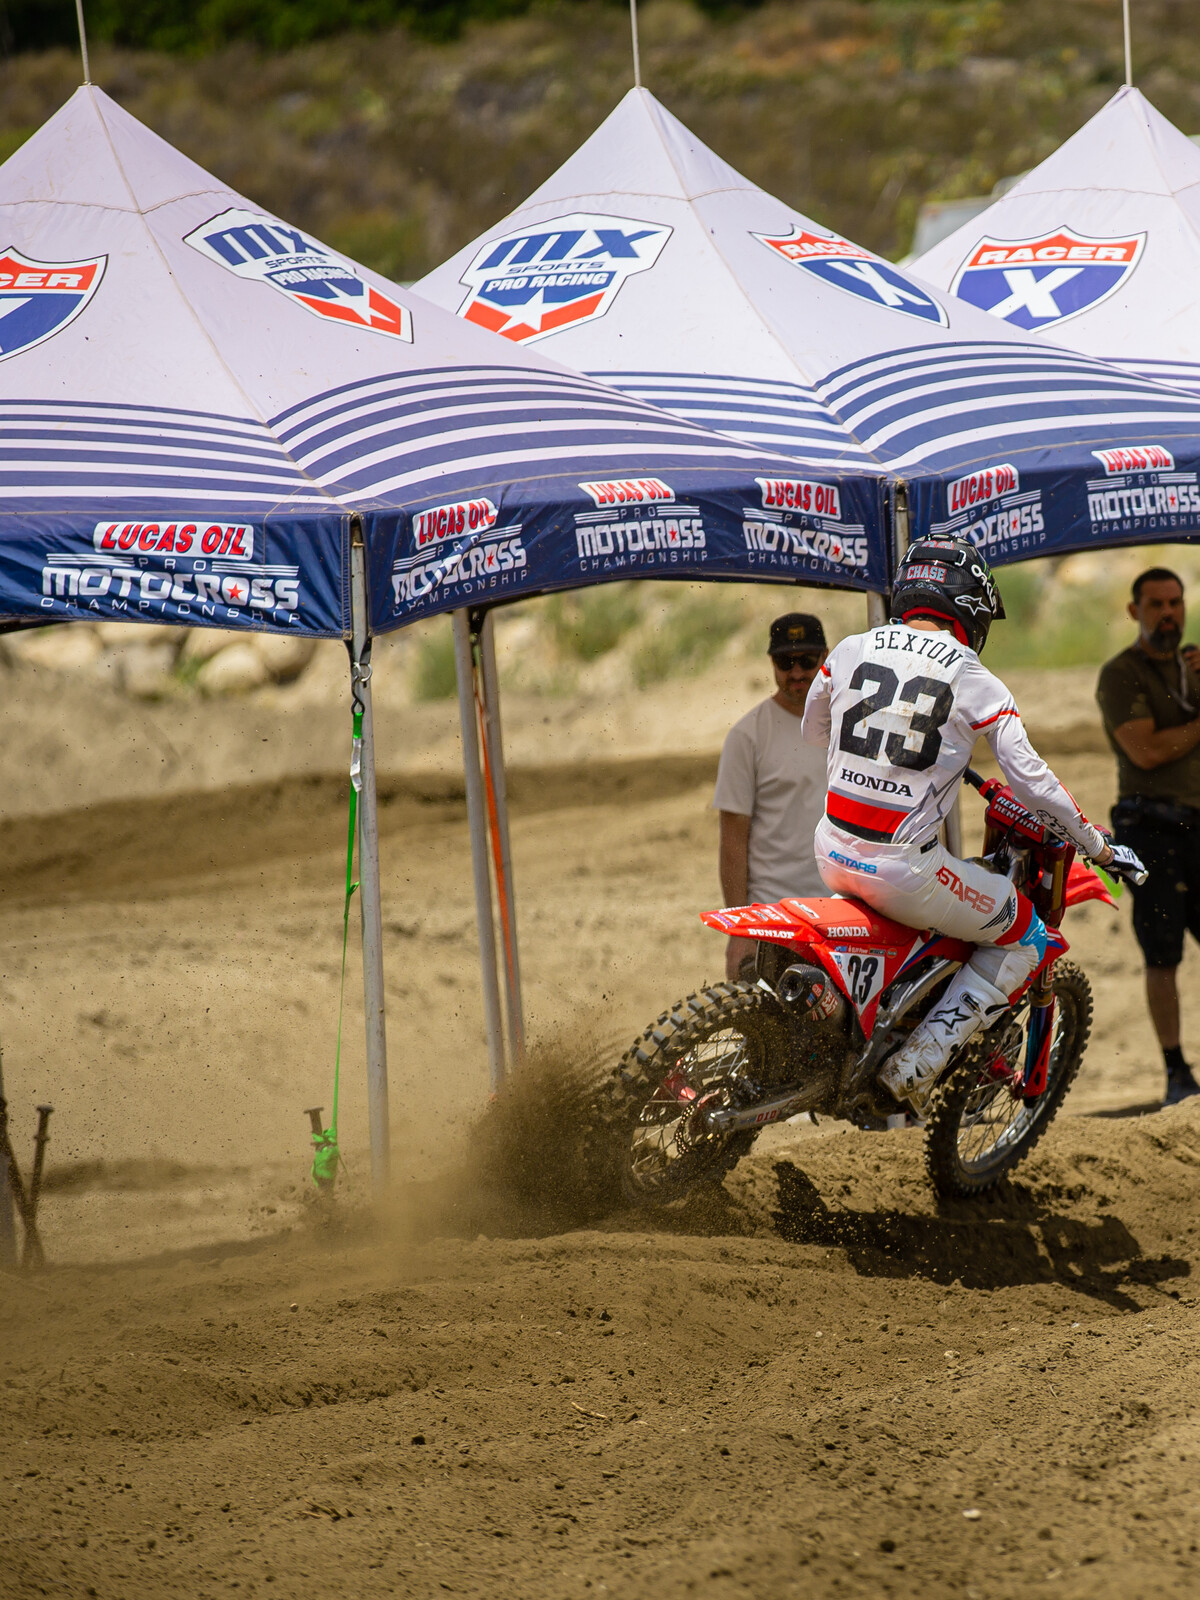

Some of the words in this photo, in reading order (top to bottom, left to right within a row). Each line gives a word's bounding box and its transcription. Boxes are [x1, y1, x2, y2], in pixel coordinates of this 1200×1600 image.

[475, 229, 663, 271] MX
[976, 246, 1127, 265] RACER
[271, 268, 307, 286] PRO
[505, 260, 606, 275] SPORTS
[485, 277, 529, 293] PRO
[529, 272, 610, 289] RACING
[825, 261, 933, 306] X
[986, 267, 1085, 318] X
[1102, 449, 1148, 472] LUCAS
[1146, 447, 1171, 468] OIL
[587, 480, 644, 504] LUCAS
[639, 479, 671, 500] OIL
[951, 471, 993, 512] LUCAS
[996, 465, 1016, 494] OIL
[1126, 474, 1158, 486] PRO
[765, 480, 812, 511] LUCAS
[815, 486, 838, 516] OIL
[969, 501, 1000, 521] PRO
[418, 504, 466, 546] LUCAS
[468, 500, 496, 529] OIL
[620, 506, 656, 520] PRO
[784, 512, 822, 530] PRO
[952, 502, 1045, 549] TOCROSS
[101, 523, 197, 553] LUCAS
[200, 525, 248, 556] OIL
[575, 518, 707, 558] MOTOCROSS
[742, 521, 869, 567] MOTOCROSS
[983, 532, 1047, 558] IONSHIP
[138, 557, 207, 572] PRO
[391, 537, 527, 605] MOTOCROSS
[580, 550, 708, 572] CHAMPIONSHIP
[906, 565, 946, 583] CHASE
[42, 566, 300, 610] MOTOCROSS
[40, 597, 300, 624] CHAMPIONSHIP
[875, 630, 964, 669] SEXTON
[839, 661, 955, 772] 23
[840, 768, 914, 798] HONDA
[828, 850, 878, 875] ASTARS
[747, 928, 795, 939] DUNLOP
[827, 926, 870, 938] HONDA
[848, 954, 879, 1006] 23
